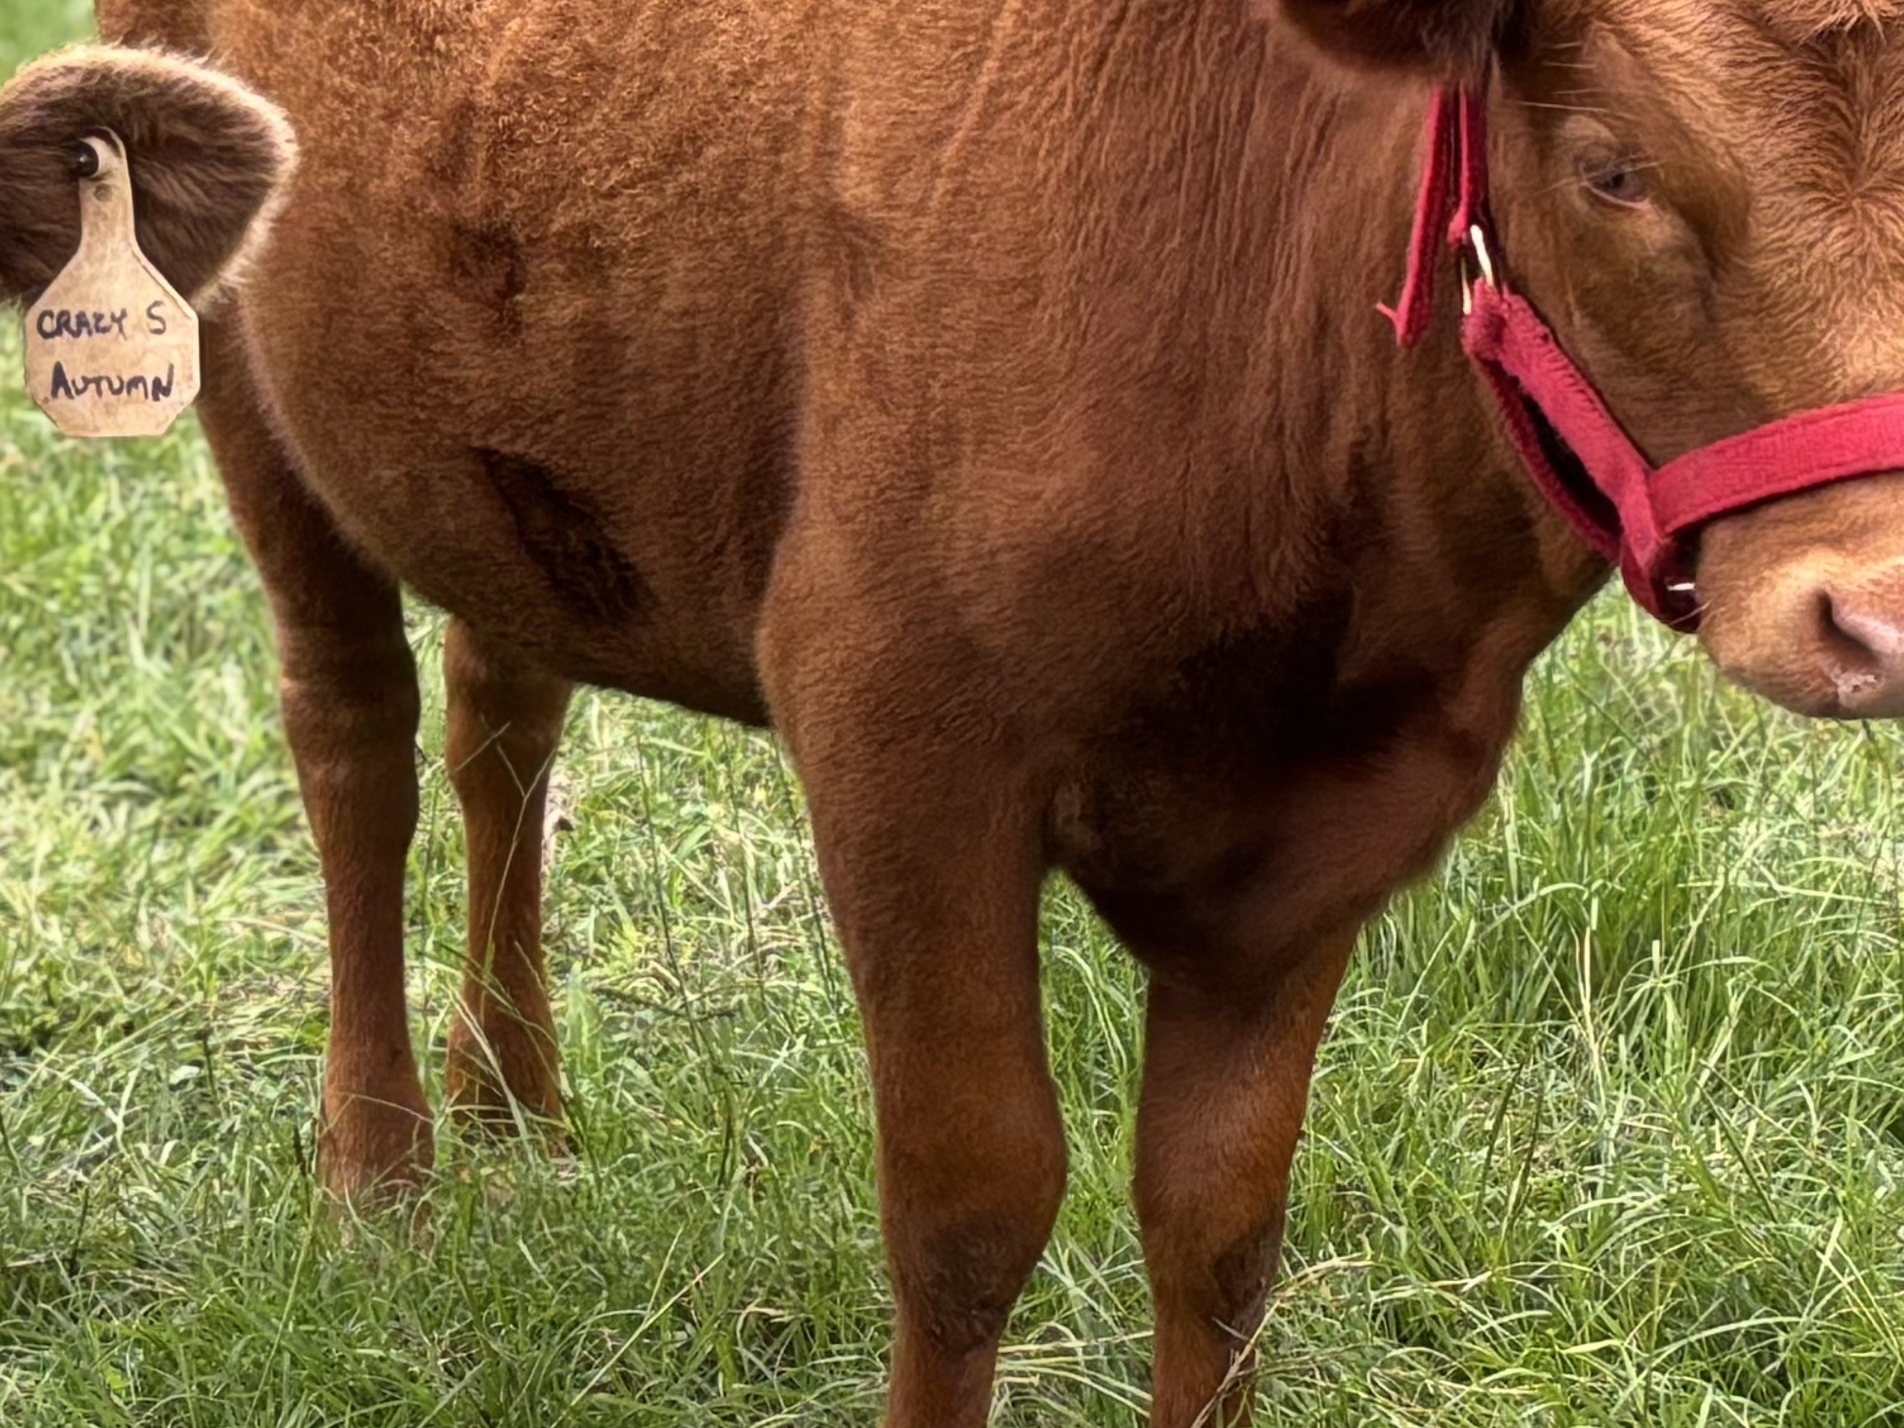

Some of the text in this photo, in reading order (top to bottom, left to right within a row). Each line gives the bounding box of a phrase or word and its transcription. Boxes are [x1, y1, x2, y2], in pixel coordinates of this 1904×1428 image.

[36, 300, 167, 340] CRAZY S
[51, 361, 174, 401] AUTUMN
